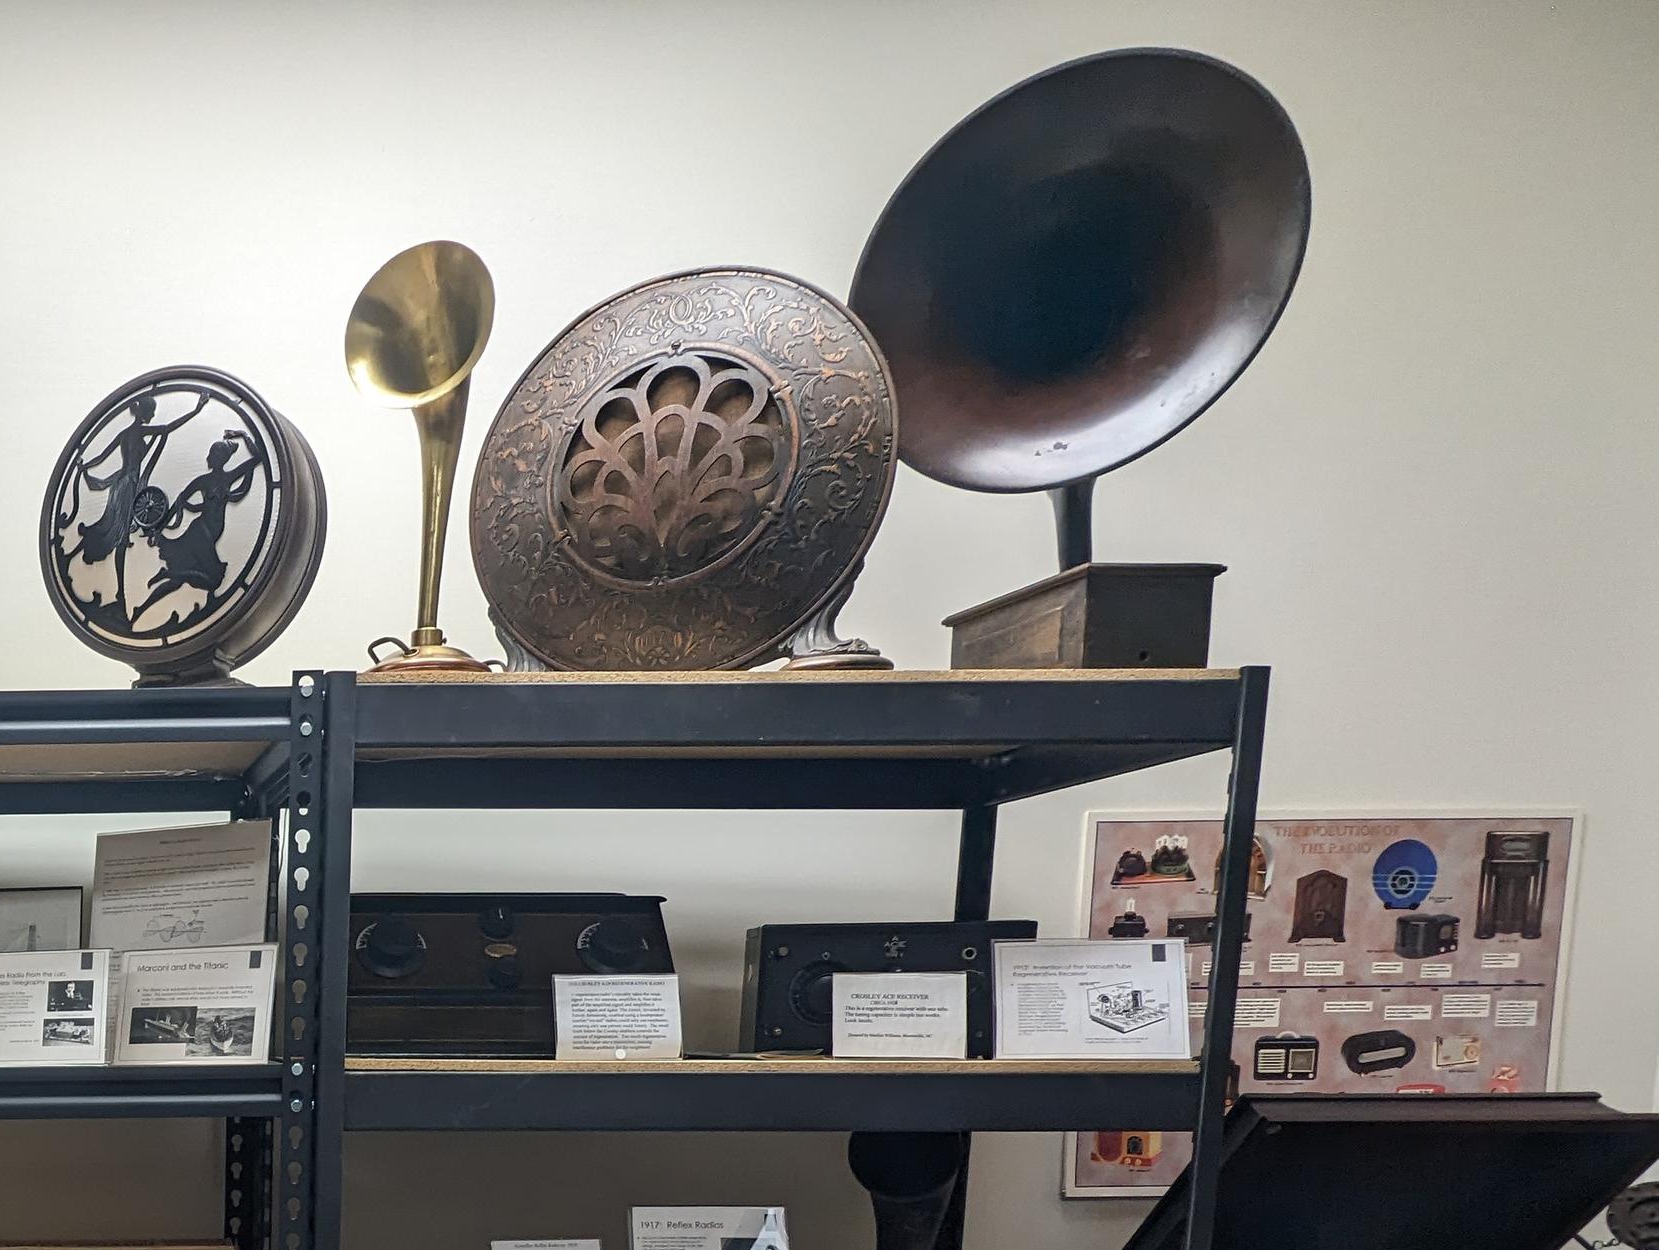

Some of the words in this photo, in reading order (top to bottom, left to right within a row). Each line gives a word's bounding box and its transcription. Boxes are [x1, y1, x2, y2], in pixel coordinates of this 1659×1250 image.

[12, 979, 45, 988] Telegraphy
[667, 1221, 692, 1229] Reflex
[695, 1221, 724, 1229] Radios
